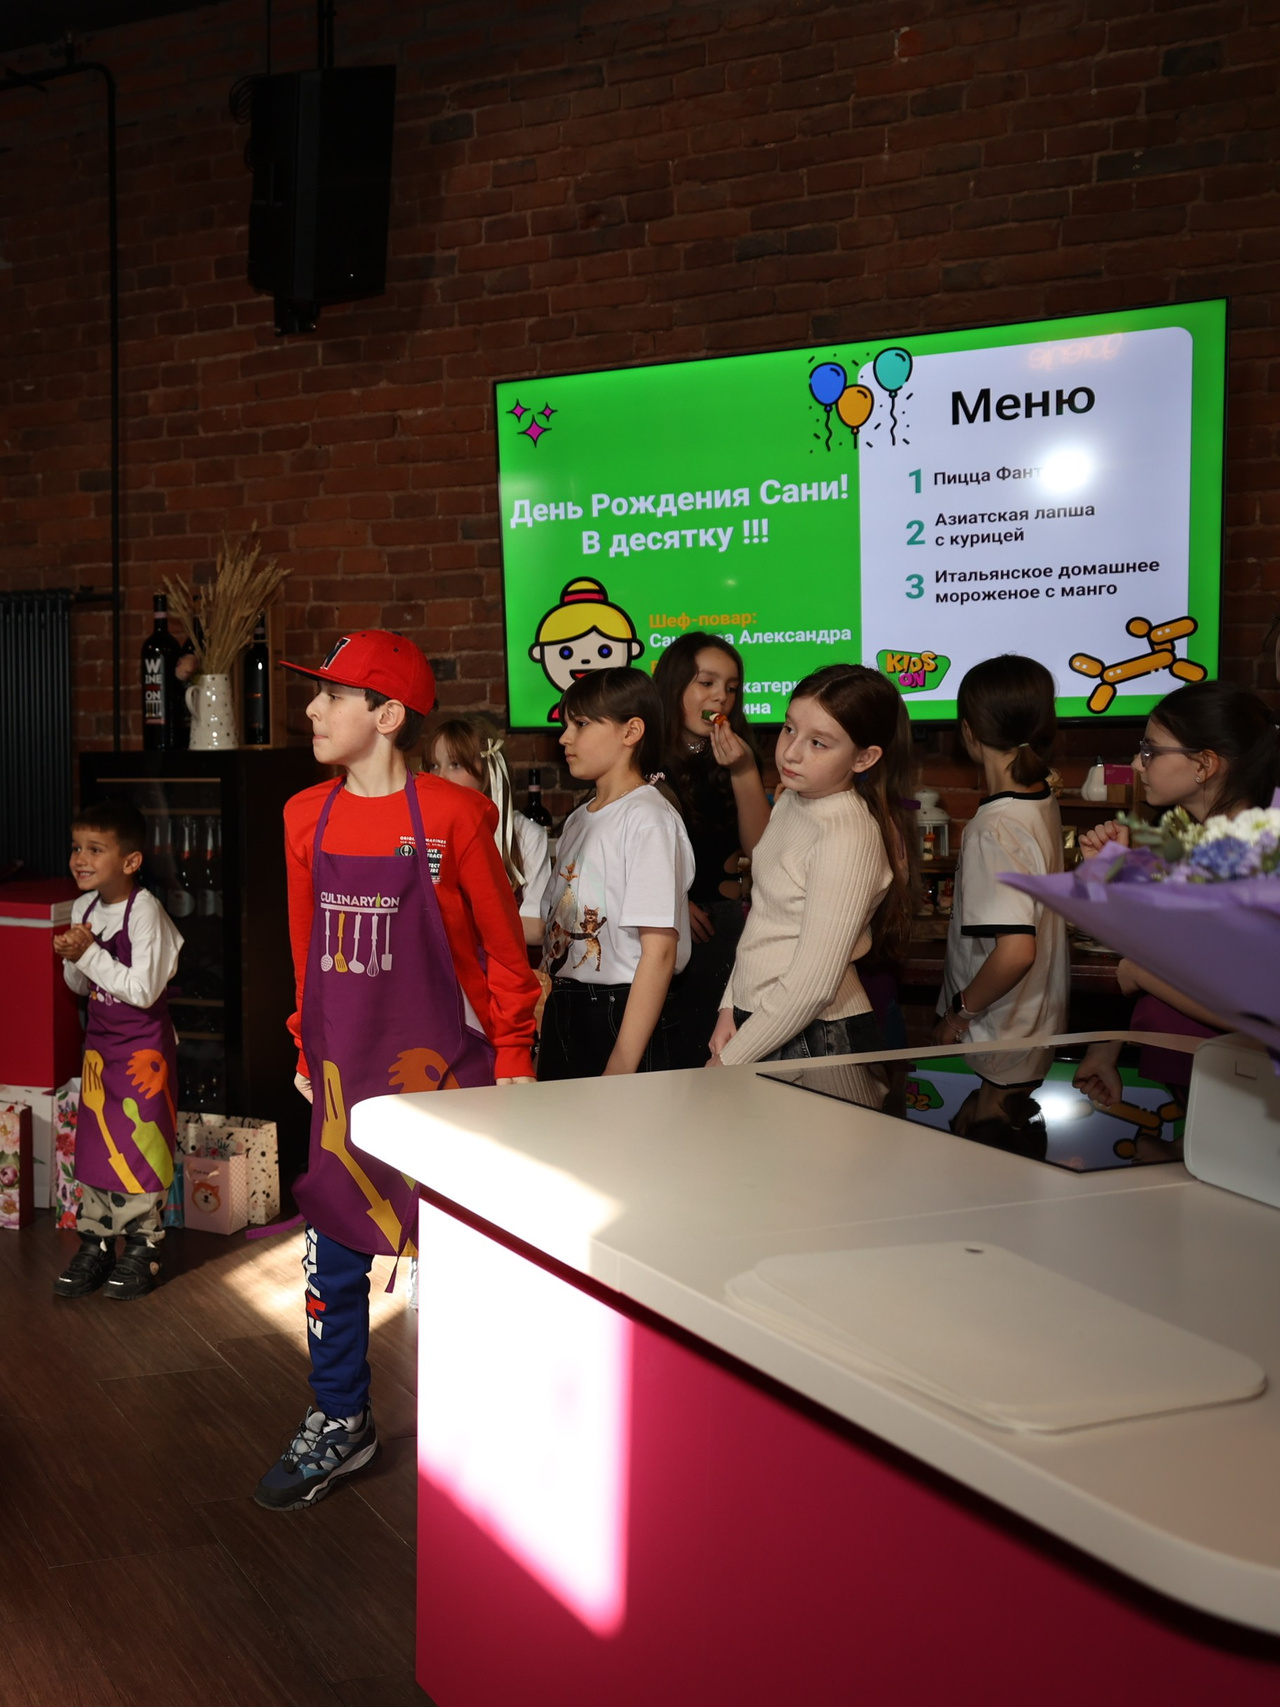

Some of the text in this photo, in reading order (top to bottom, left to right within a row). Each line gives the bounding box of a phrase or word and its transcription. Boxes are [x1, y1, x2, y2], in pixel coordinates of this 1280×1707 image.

[951, 384, 1096, 426] Меню
[908, 466, 1044, 494] 1 Пицца Фант
[510, 473, 849, 529] День Рождения Сани!
[906, 504, 1096, 546] 2 Азиатская лапша
[935, 527, 1025, 548] с курицей
[581, 518, 769, 558] В десятку !!!
[905, 560, 1160, 599] 3 Итальянское домашнее
[935, 583, 1118, 605] мороженое с манго
[649, 612, 757, 630] Шеф-повар:
[739, 628, 852, 645] Александра
[885, 650, 937, 673] KIDS
[898, 669, 926, 687] ON
